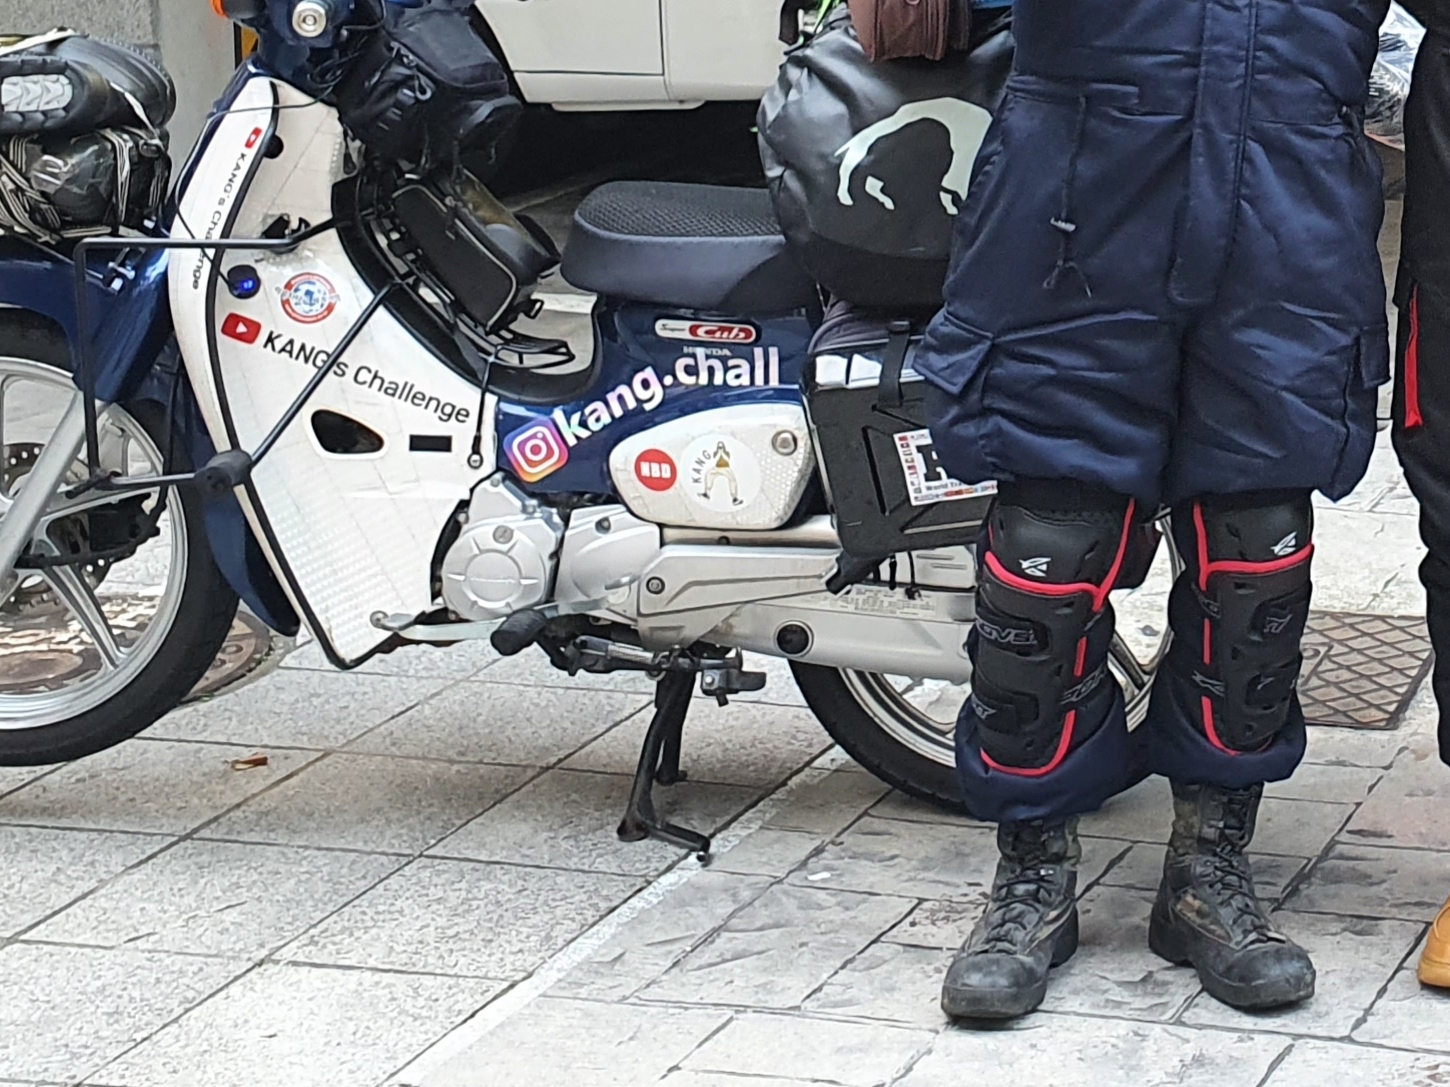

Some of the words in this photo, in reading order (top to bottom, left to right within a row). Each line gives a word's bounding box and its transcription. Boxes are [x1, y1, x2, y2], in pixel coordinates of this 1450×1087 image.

[696, 325, 747, 339] Cub
[353, 365, 470, 424] Challenge
[553, 346, 780, 447] kang.chall
[692, 449, 712, 484] KANG
